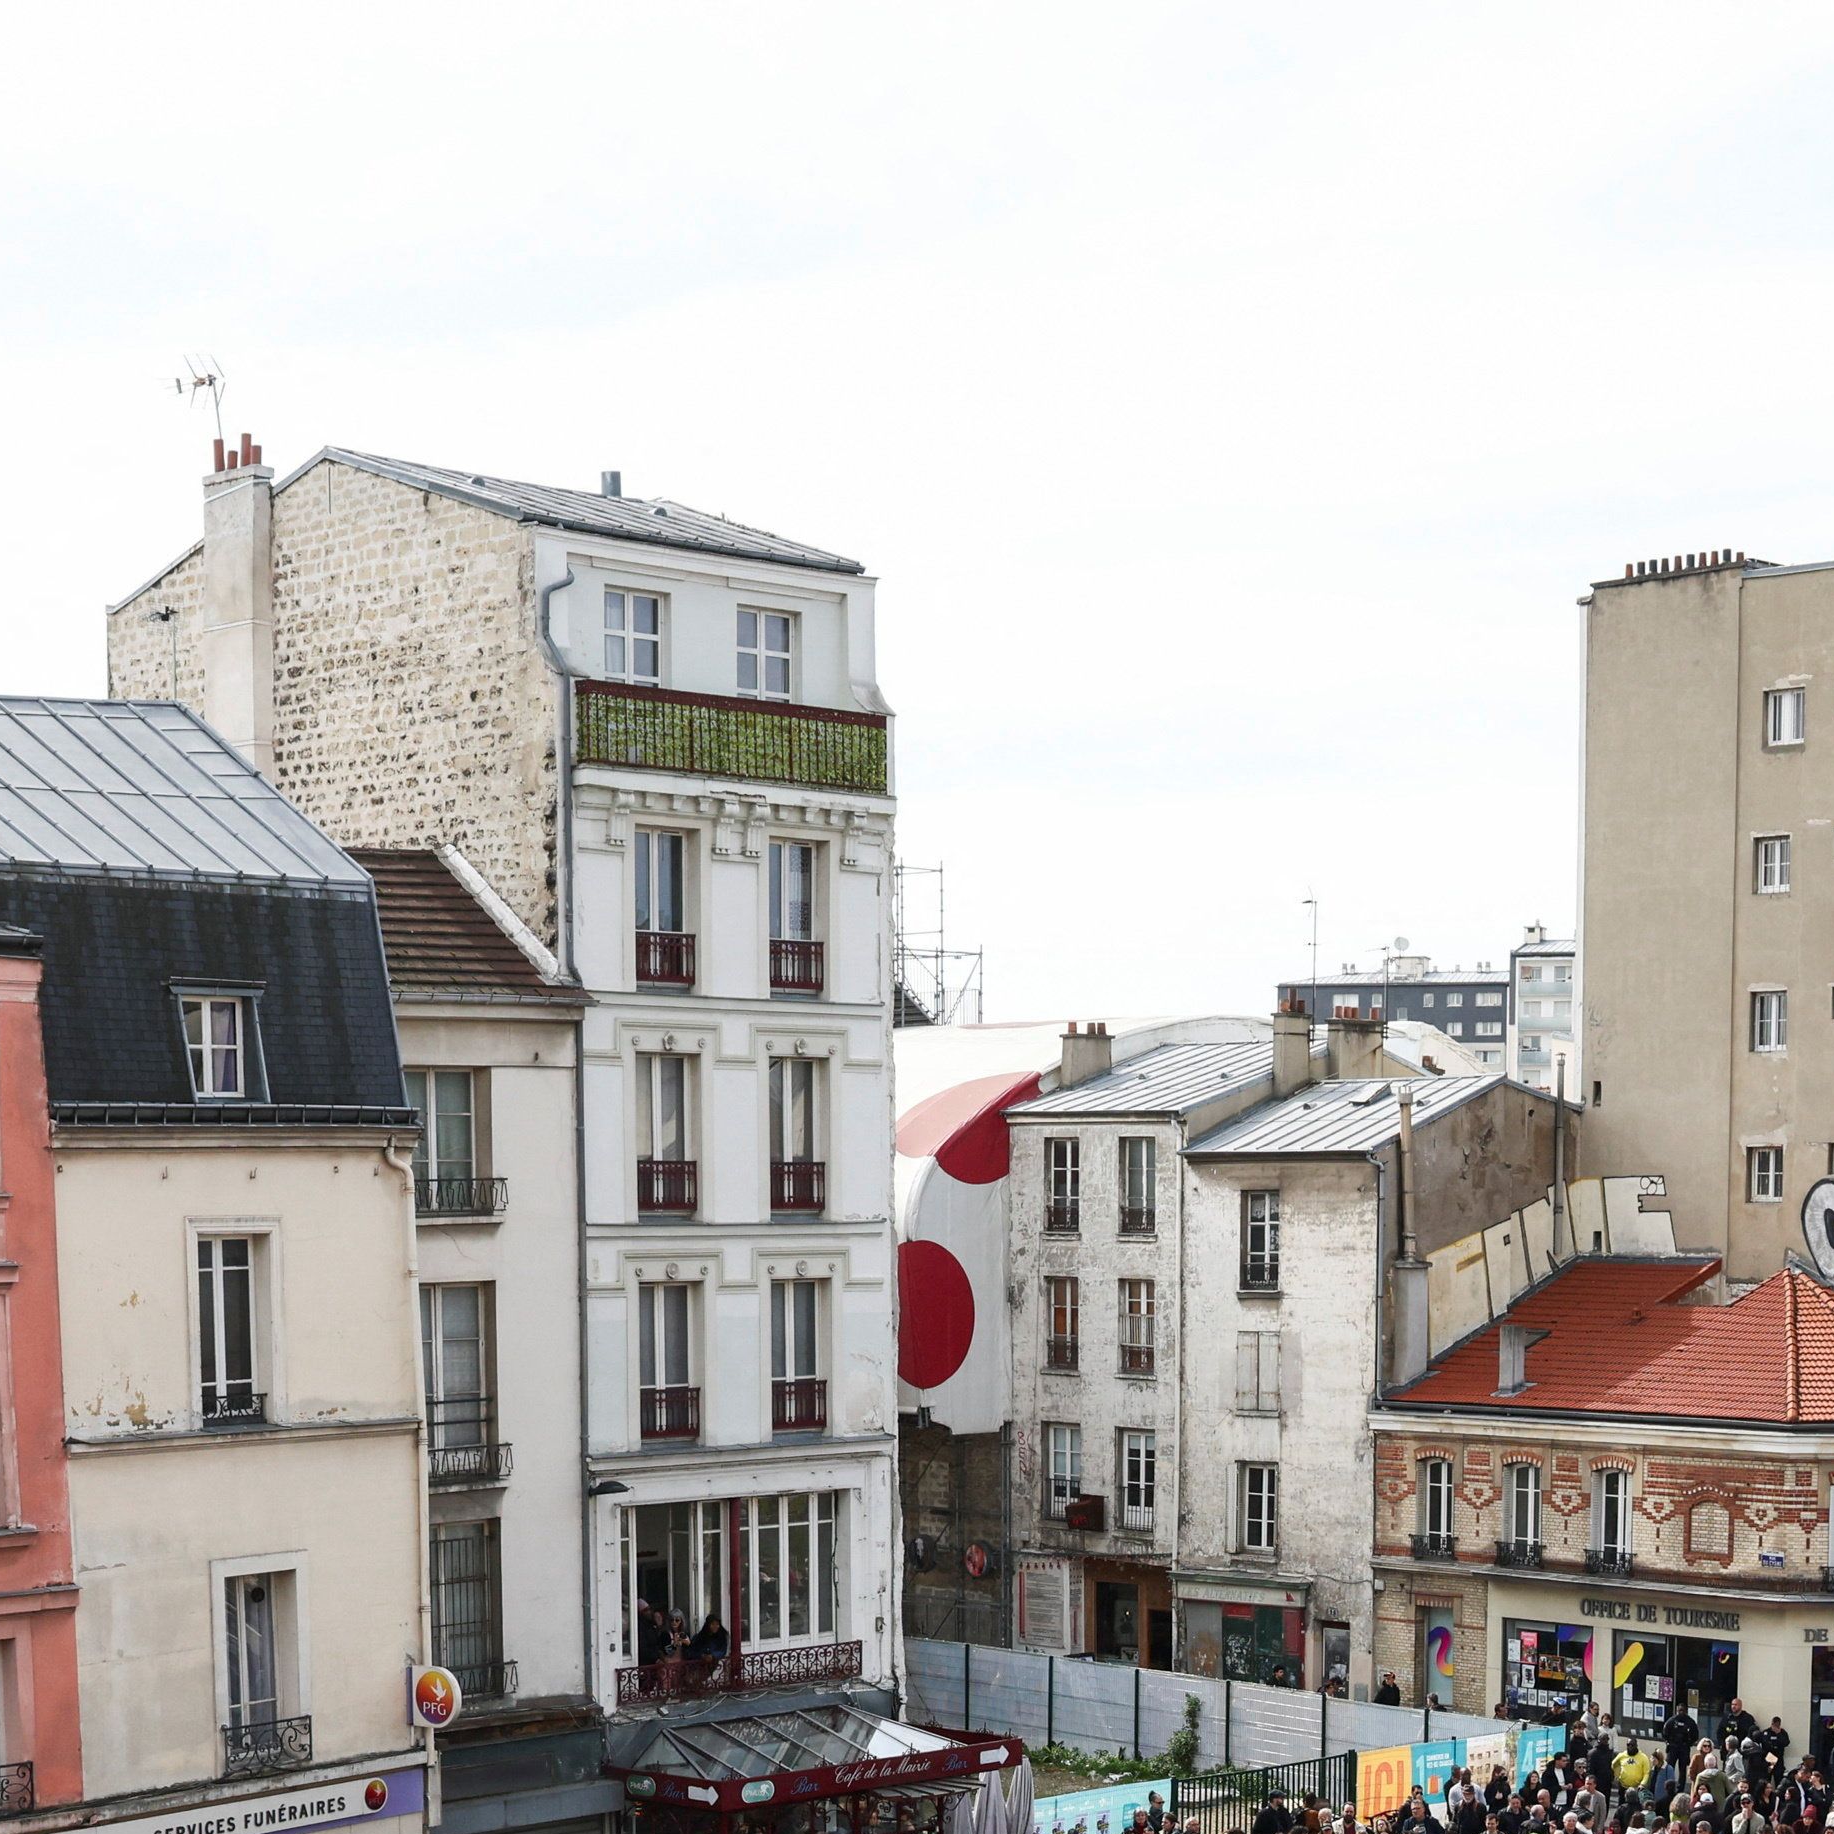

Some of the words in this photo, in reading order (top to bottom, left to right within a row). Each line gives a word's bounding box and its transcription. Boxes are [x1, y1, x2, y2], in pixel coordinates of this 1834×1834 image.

[1580, 1598, 1630, 1621] OFFICE
[1636, 1603, 1658, 1624] DE
[1663, 1606, 1740, 1631] TOURISME
[1804, 1627, 1828, 1643] DE
[423, 1702, 447, 1716] PFG
[834, 1766, 865, 1785] Café
[865, 1765, 878, 1779] de
[879, 1764, 891, 1777] la
[892, 1757, 931, 1776] Mairie
[790, 1776, 818, 1795] Bar
[1363, 1760, 1405, 1819] ICI
[244, 1796, 346, 1830] FUNÉRAIRES
